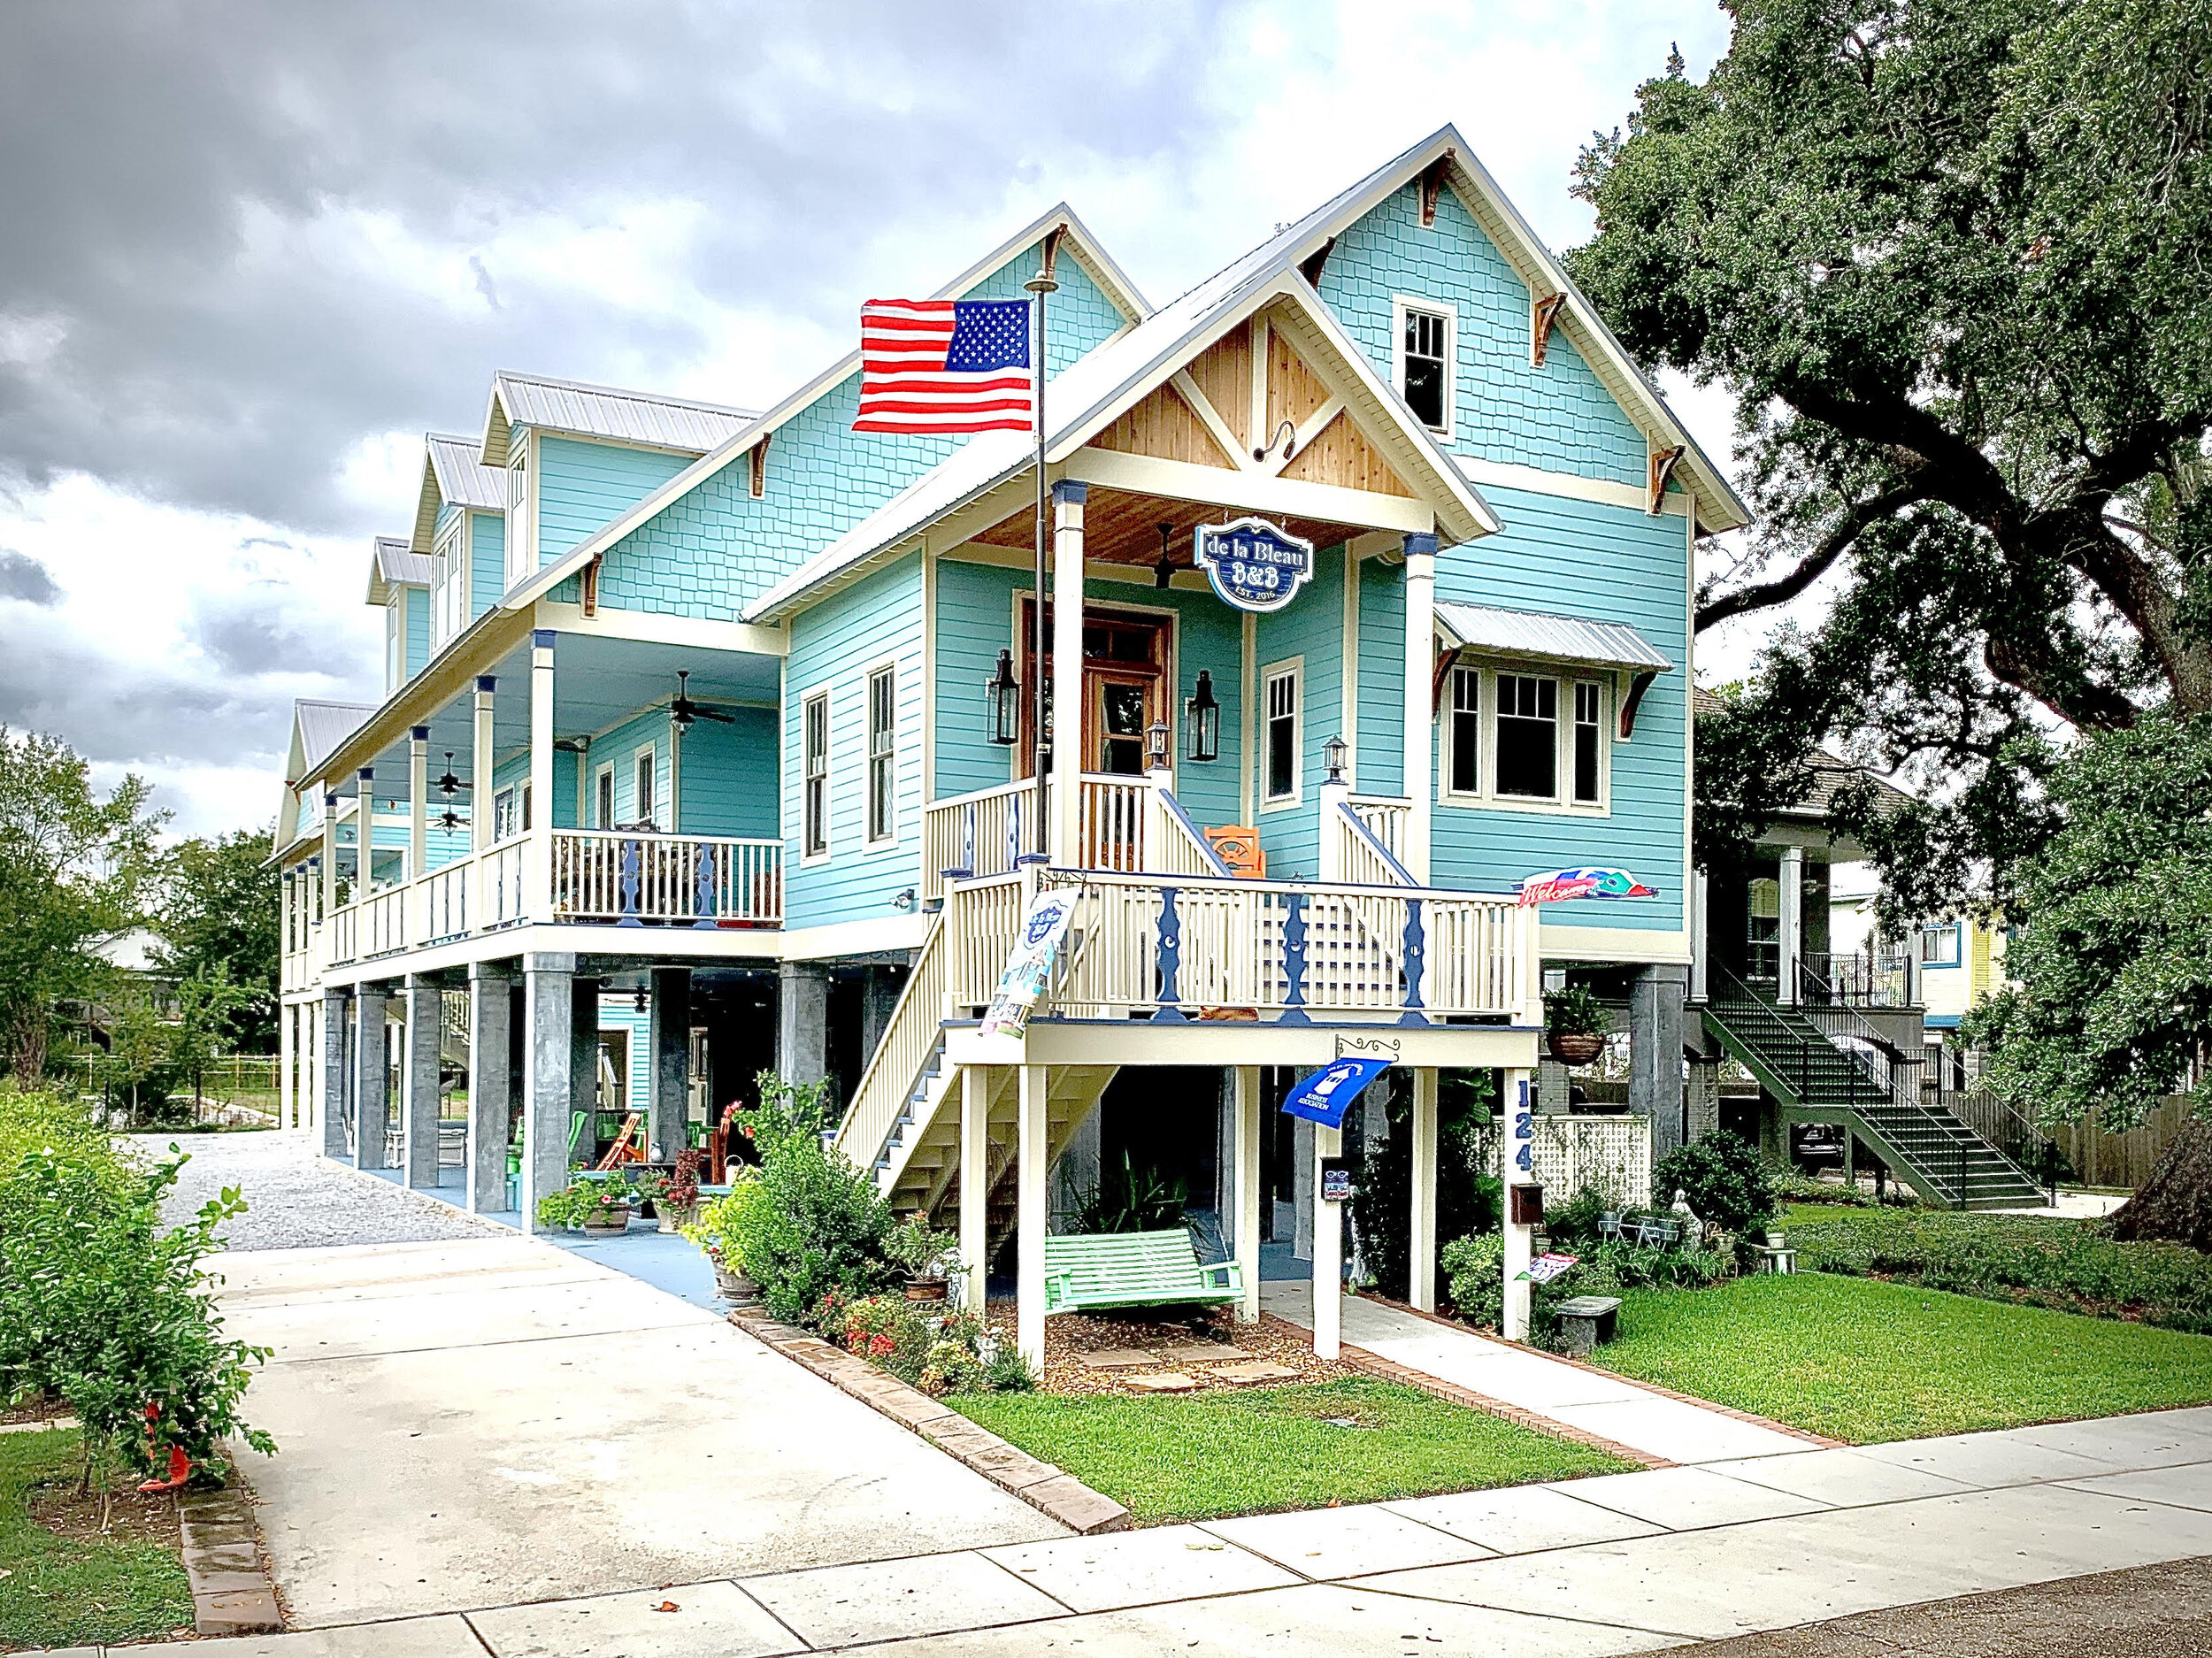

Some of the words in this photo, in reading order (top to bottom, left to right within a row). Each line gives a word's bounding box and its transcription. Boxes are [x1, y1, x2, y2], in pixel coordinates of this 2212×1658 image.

[1208, 536, 1229, 555] de
[1233, 539, 1248, 558] la
[1254, 541, 1303, 565] Bleau
[1232, 562, 1279, 588] B&B
[1256, 590, 1275, 600] 2016
[1524, 882, 1587, 903] Welcome
[1297, 1098, 1329, 1110] ASSOCIATION
[1305, 1093, 1328, 1102] BUSINESS
